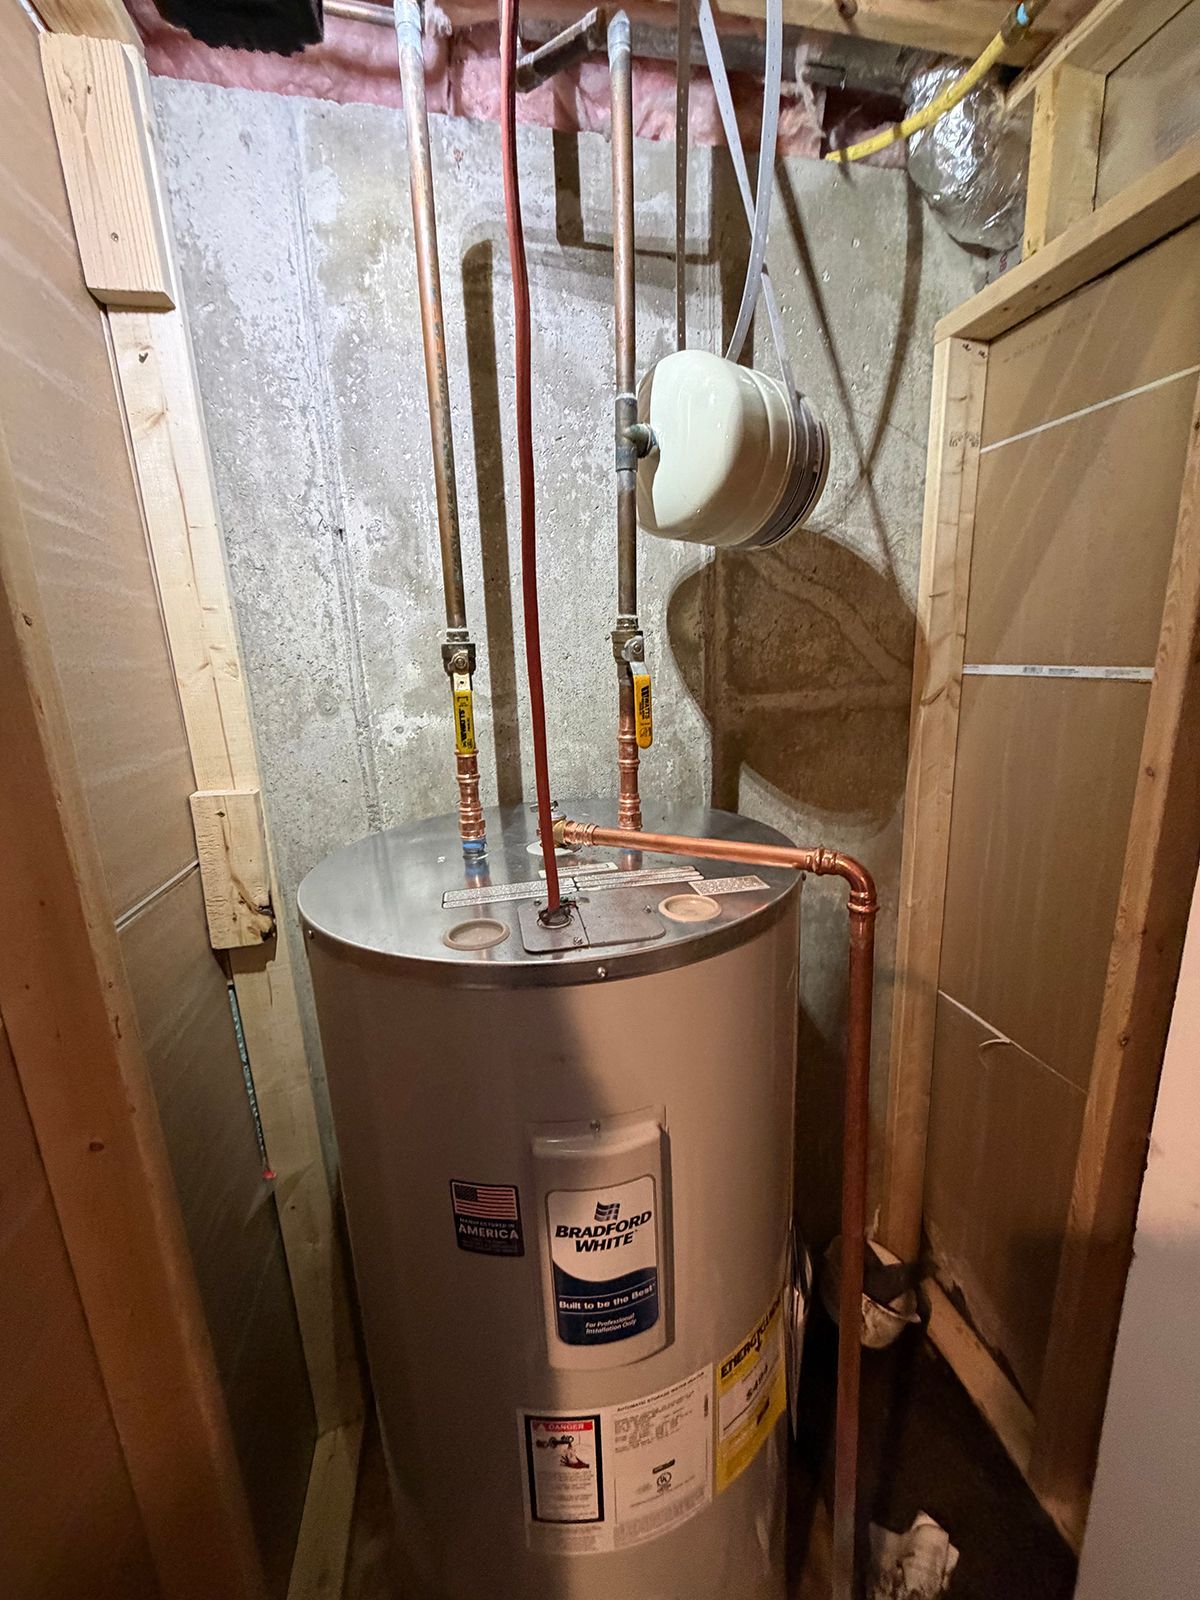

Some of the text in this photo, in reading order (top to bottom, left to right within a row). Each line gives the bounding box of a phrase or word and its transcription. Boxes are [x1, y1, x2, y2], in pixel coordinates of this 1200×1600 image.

[459, 1224, 519, 1240] AMERICA
[556, 1211, 652, 1238] BRADFORD
[575, 1231, 634, 1252] WHITE
[559, 1300, 581, 1310] Built
[584, 1302, 594, 1310] to
[597, 1300, 610, 1309] be
[613, 1296, 629, 1306] the
[586, 1319, 636, 1334] Installation Only
[597, 1313, 635, 1328] Professional
[548, 1422, 584, 1430] DANGER
